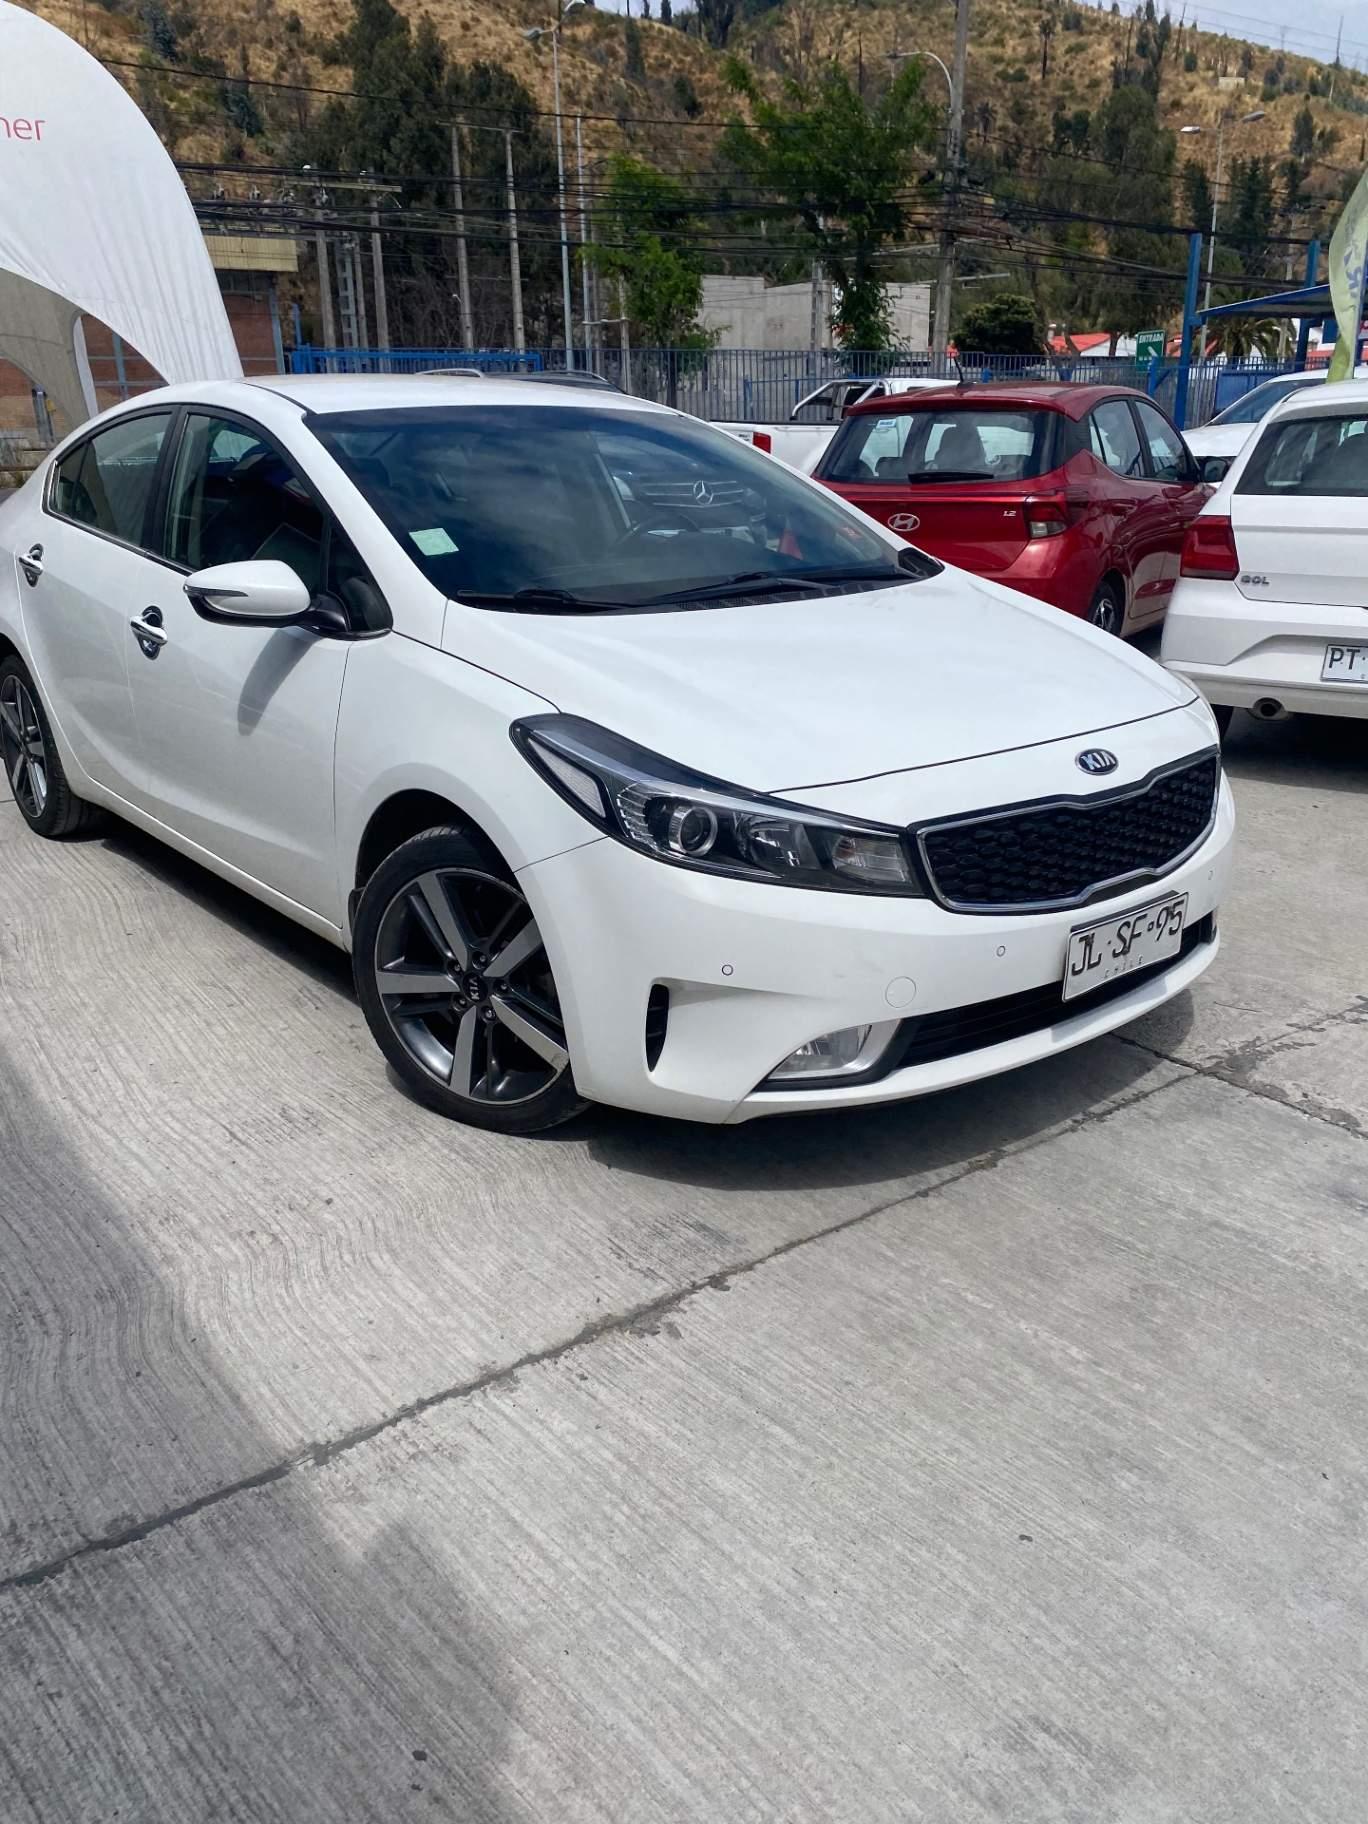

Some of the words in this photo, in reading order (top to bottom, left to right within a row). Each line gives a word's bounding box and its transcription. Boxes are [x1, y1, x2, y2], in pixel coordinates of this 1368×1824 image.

[1138, 332, 1164, 344] ENTRADA
[1080, 750, 1116, 770] KIA
[468, 976, 480, 1000] KIA
